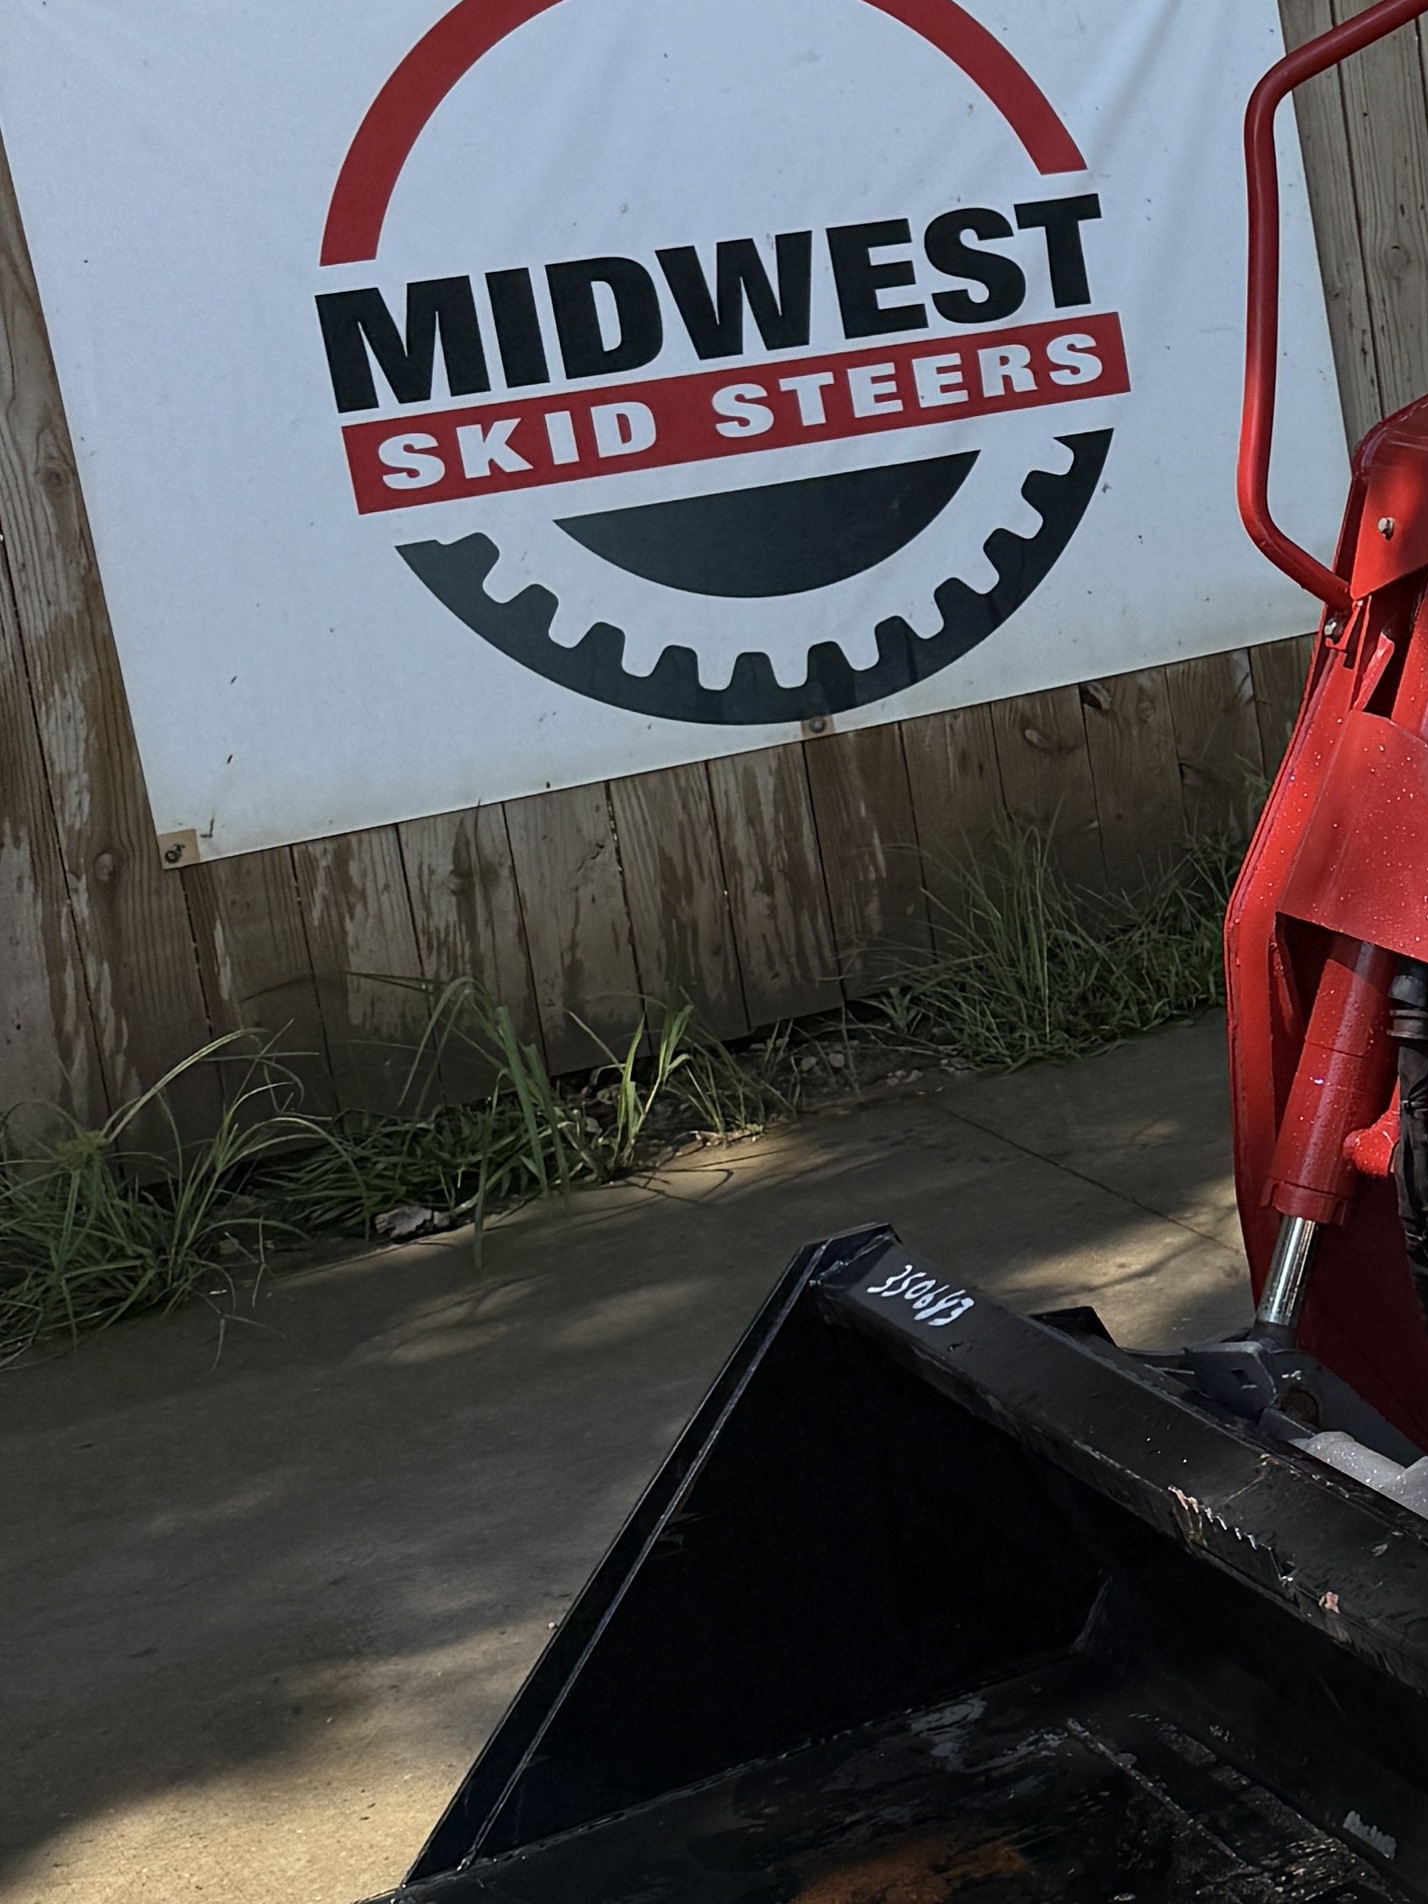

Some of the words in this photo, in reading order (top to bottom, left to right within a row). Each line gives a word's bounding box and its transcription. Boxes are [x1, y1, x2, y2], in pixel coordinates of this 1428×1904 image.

[315, 193, 1101, 414] MIDWEST
[375, 401, 658, 492] SKID
[712, 332, 1105, 439] STEERS
